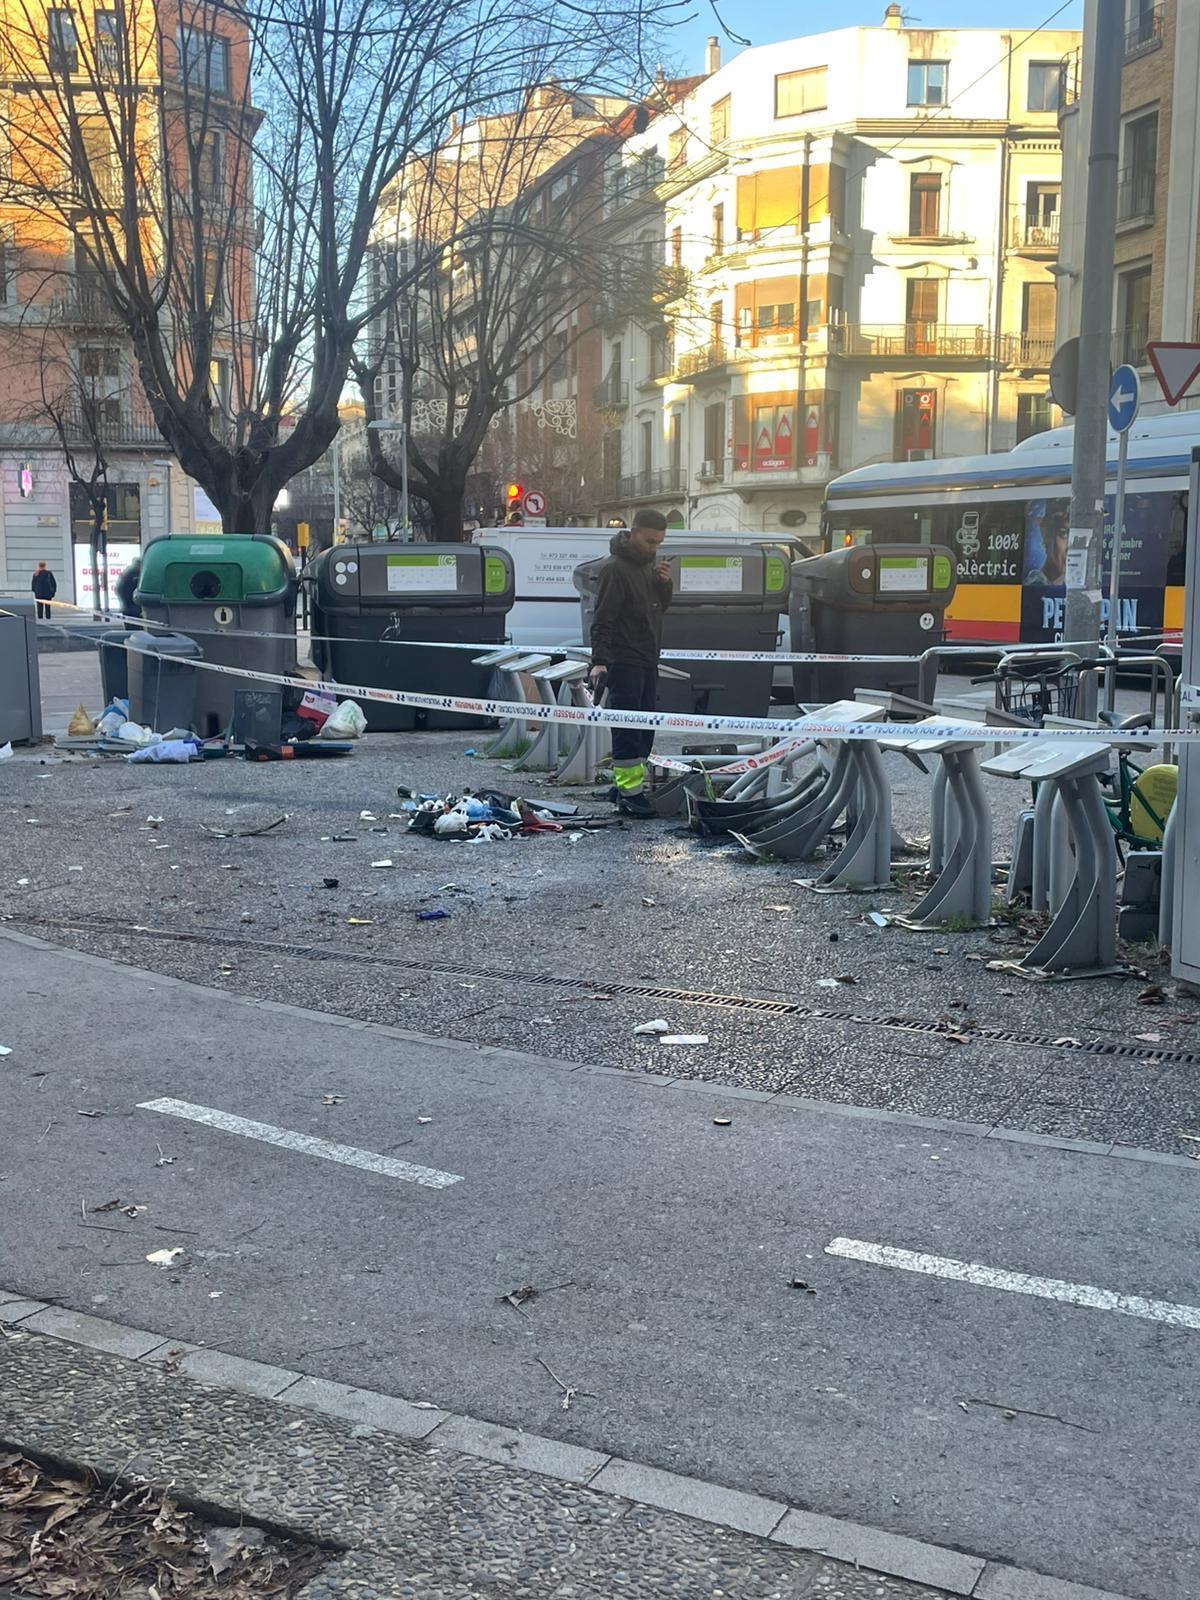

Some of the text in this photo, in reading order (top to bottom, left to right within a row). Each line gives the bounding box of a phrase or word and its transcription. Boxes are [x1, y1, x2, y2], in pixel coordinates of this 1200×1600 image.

[1104, 524, 1127, 534] IROA
[987, 532, 1020, 551] 100%
[1108, 538, 1143, 549] dembre
[956, 559, 1017, 576] elèctric
[1180, 690, 1193, 702] AL
[497, 704, 516, 713] LOCAL
[553, 709, 576, 719] PASSEU
[576, 711, 585, 719] NO
[603, 712, 623, 722] LOCAL
[667, 717, 693, 727] PASSEU
[693, 719, 704, 727] NO
[726, 719, 750, 729] LOCAL
[872, 725, 900, 734] LOCAL
